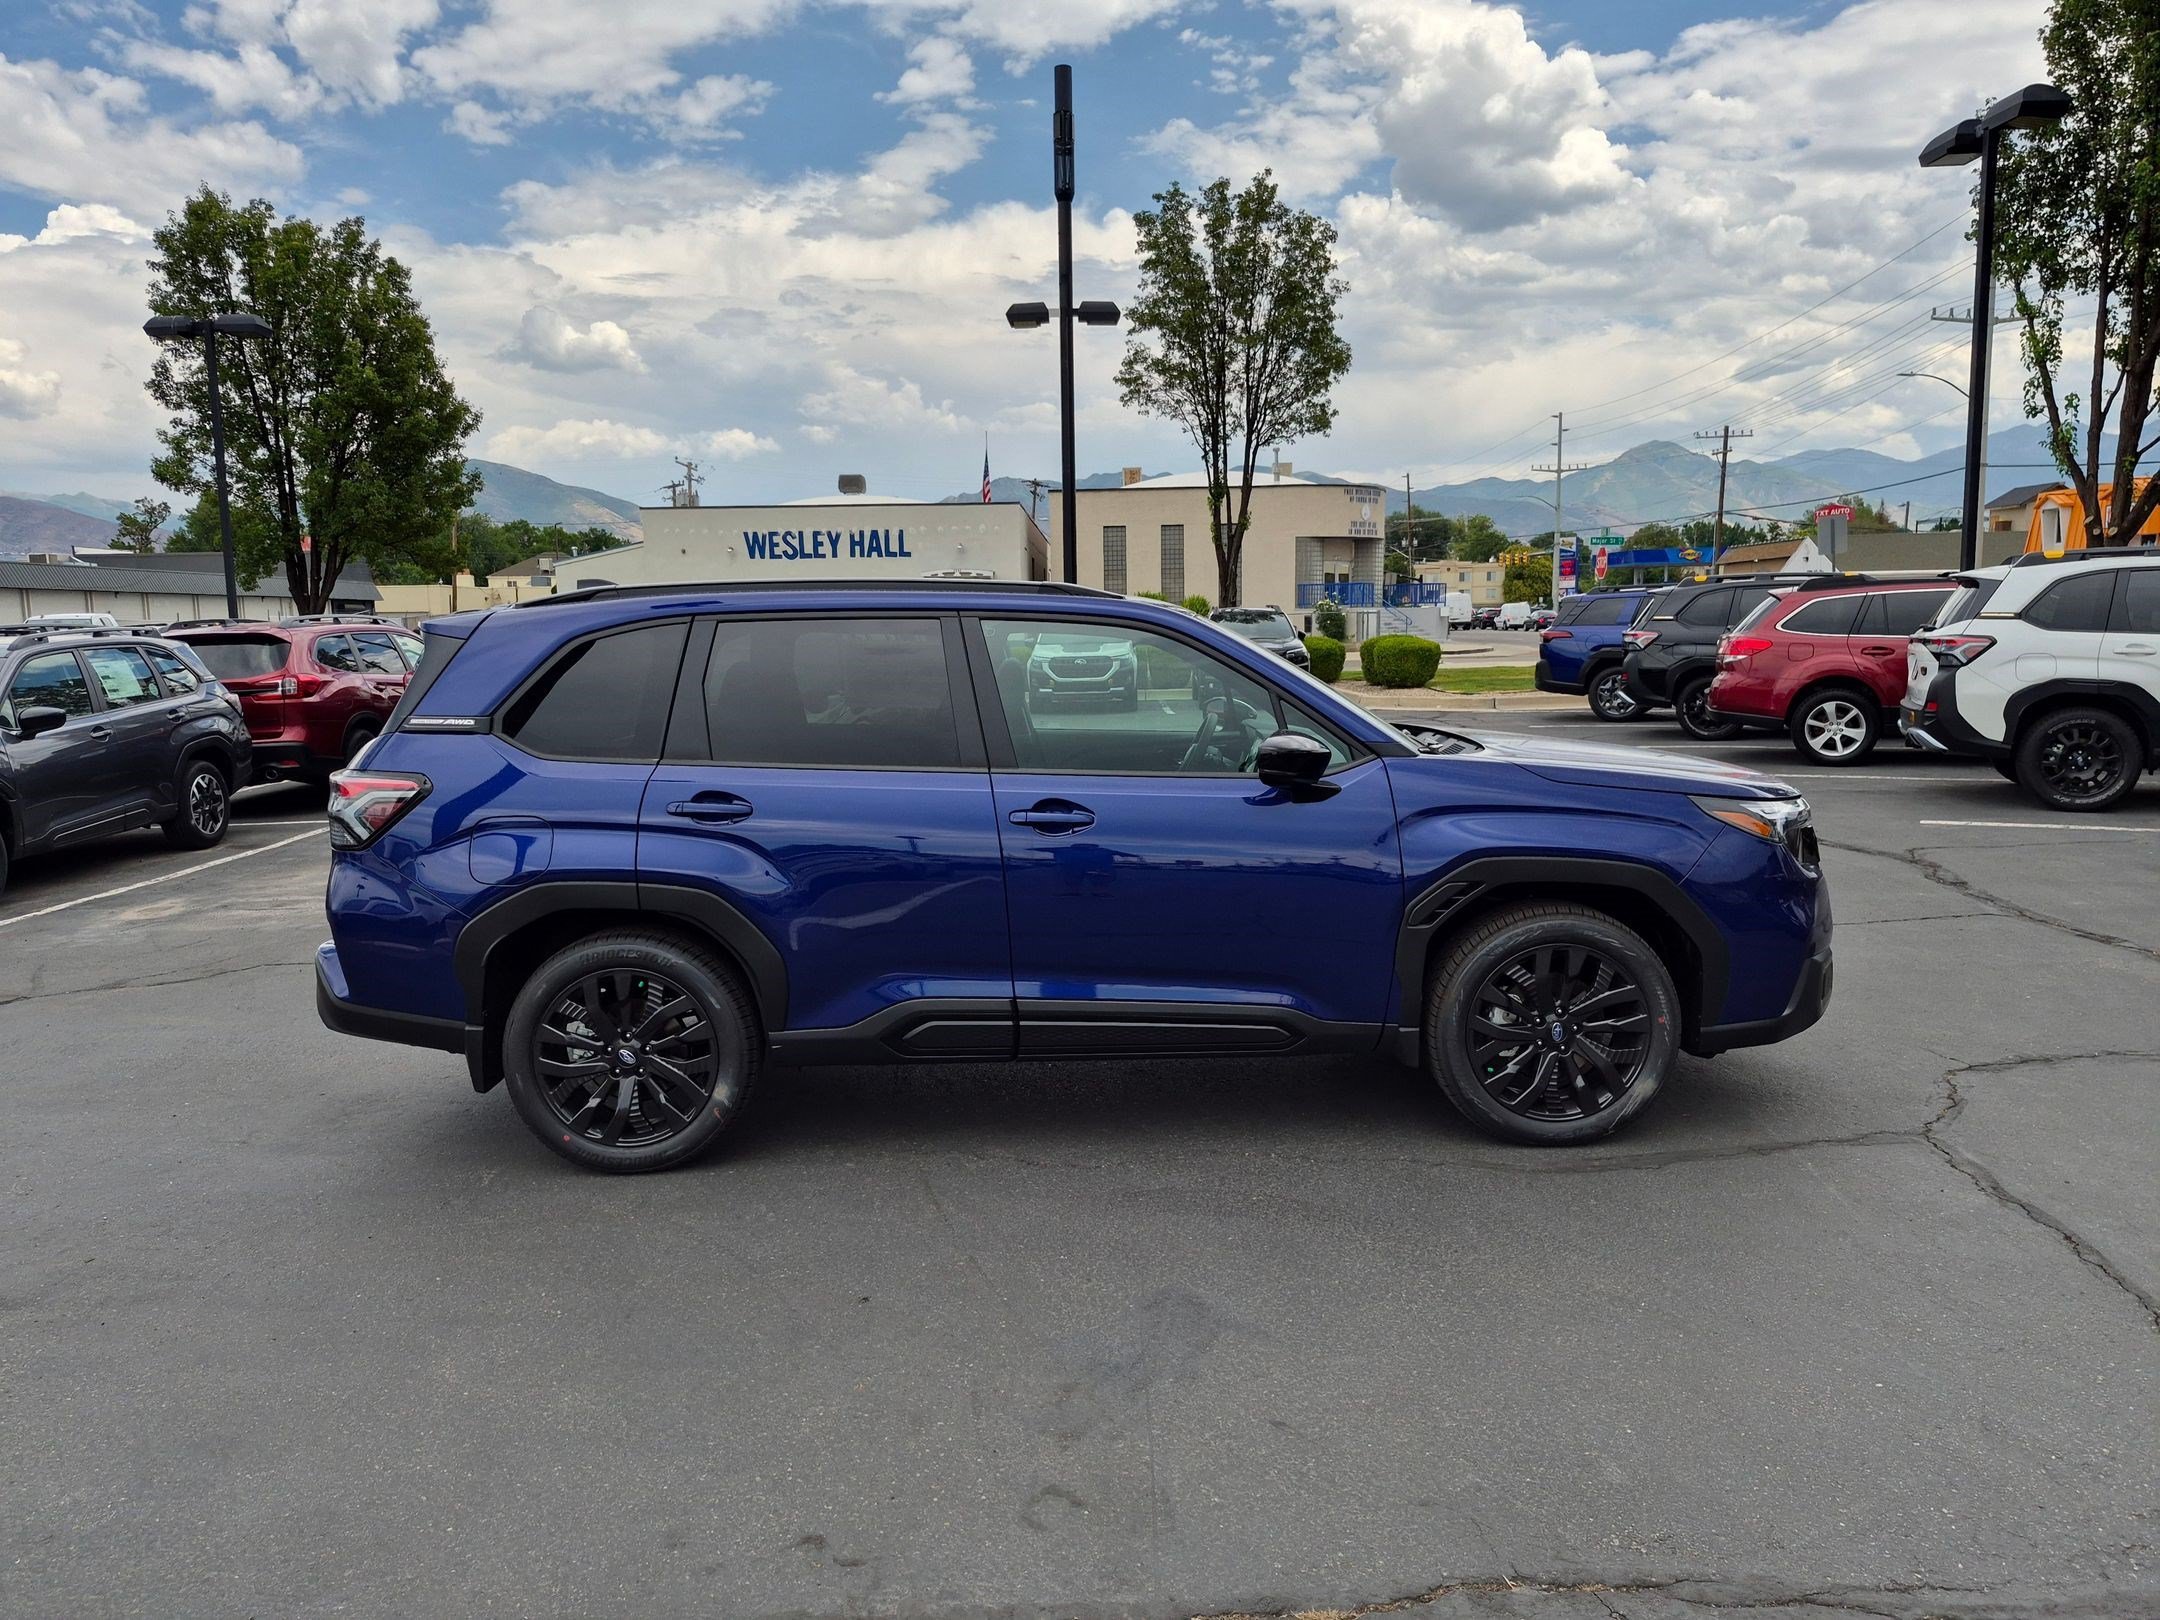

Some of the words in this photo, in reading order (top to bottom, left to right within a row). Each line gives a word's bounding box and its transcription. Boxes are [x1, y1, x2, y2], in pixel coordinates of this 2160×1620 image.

[1830, 508, 1850, 516] AUTO
[743, 530, 842, 561] WESLEY
[849, 529, 912, 558] HALL
[1597, 556, 1607, 569] STOP
[442, 718, 476, 726] AWD
